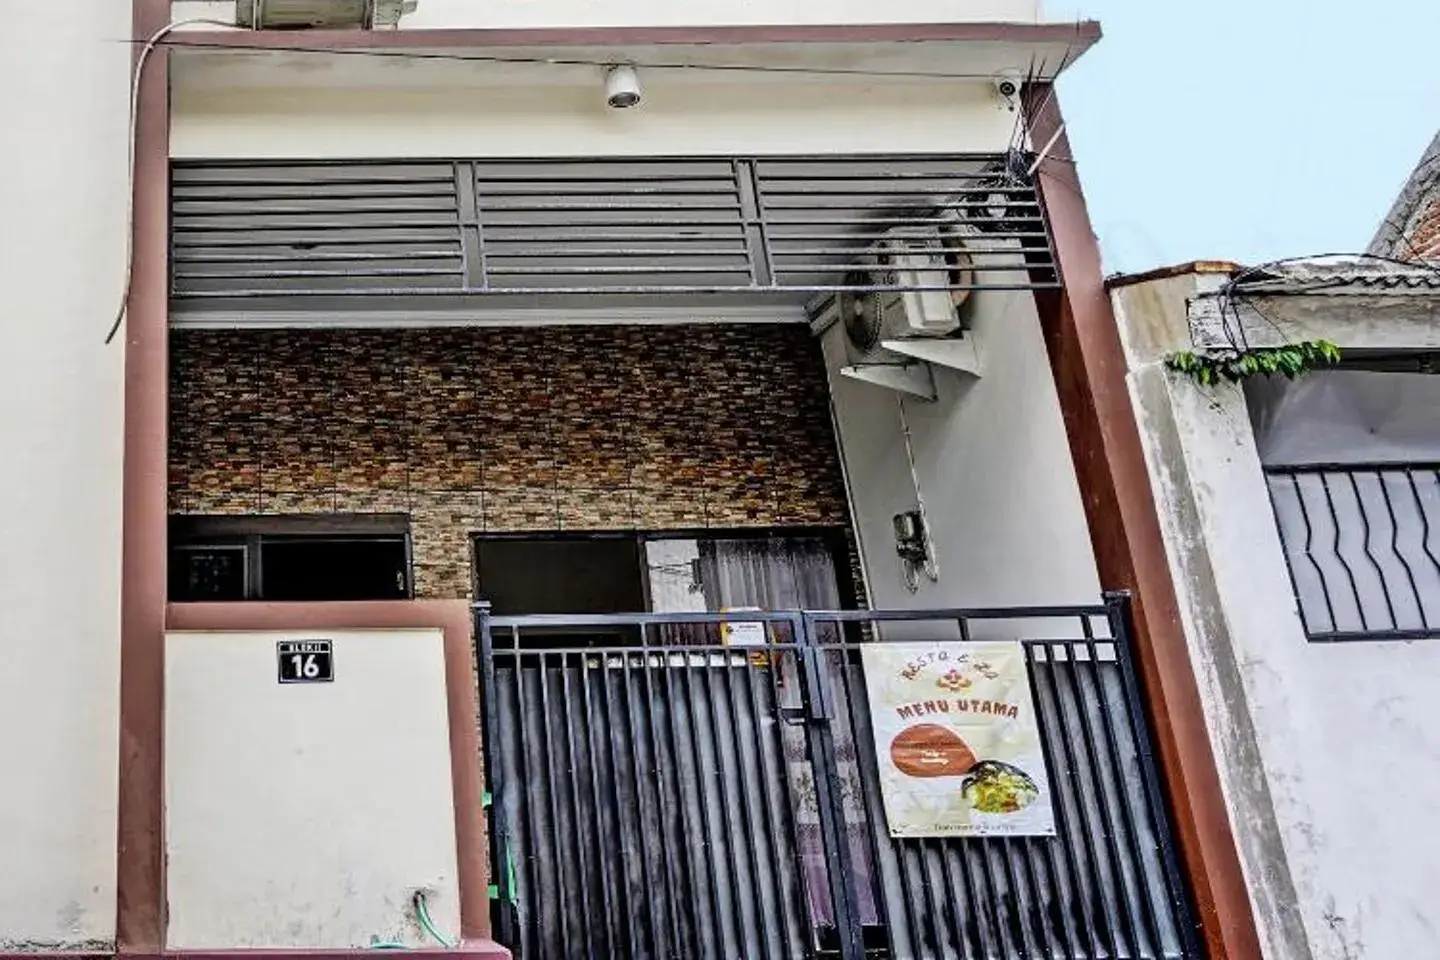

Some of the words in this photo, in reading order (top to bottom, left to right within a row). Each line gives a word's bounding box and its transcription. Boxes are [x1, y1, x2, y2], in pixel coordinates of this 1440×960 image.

[291, 654, 320, 678] 16
[896, 699, 950, 721] MENU
[957, 699, 1019, 720] UTAMA
